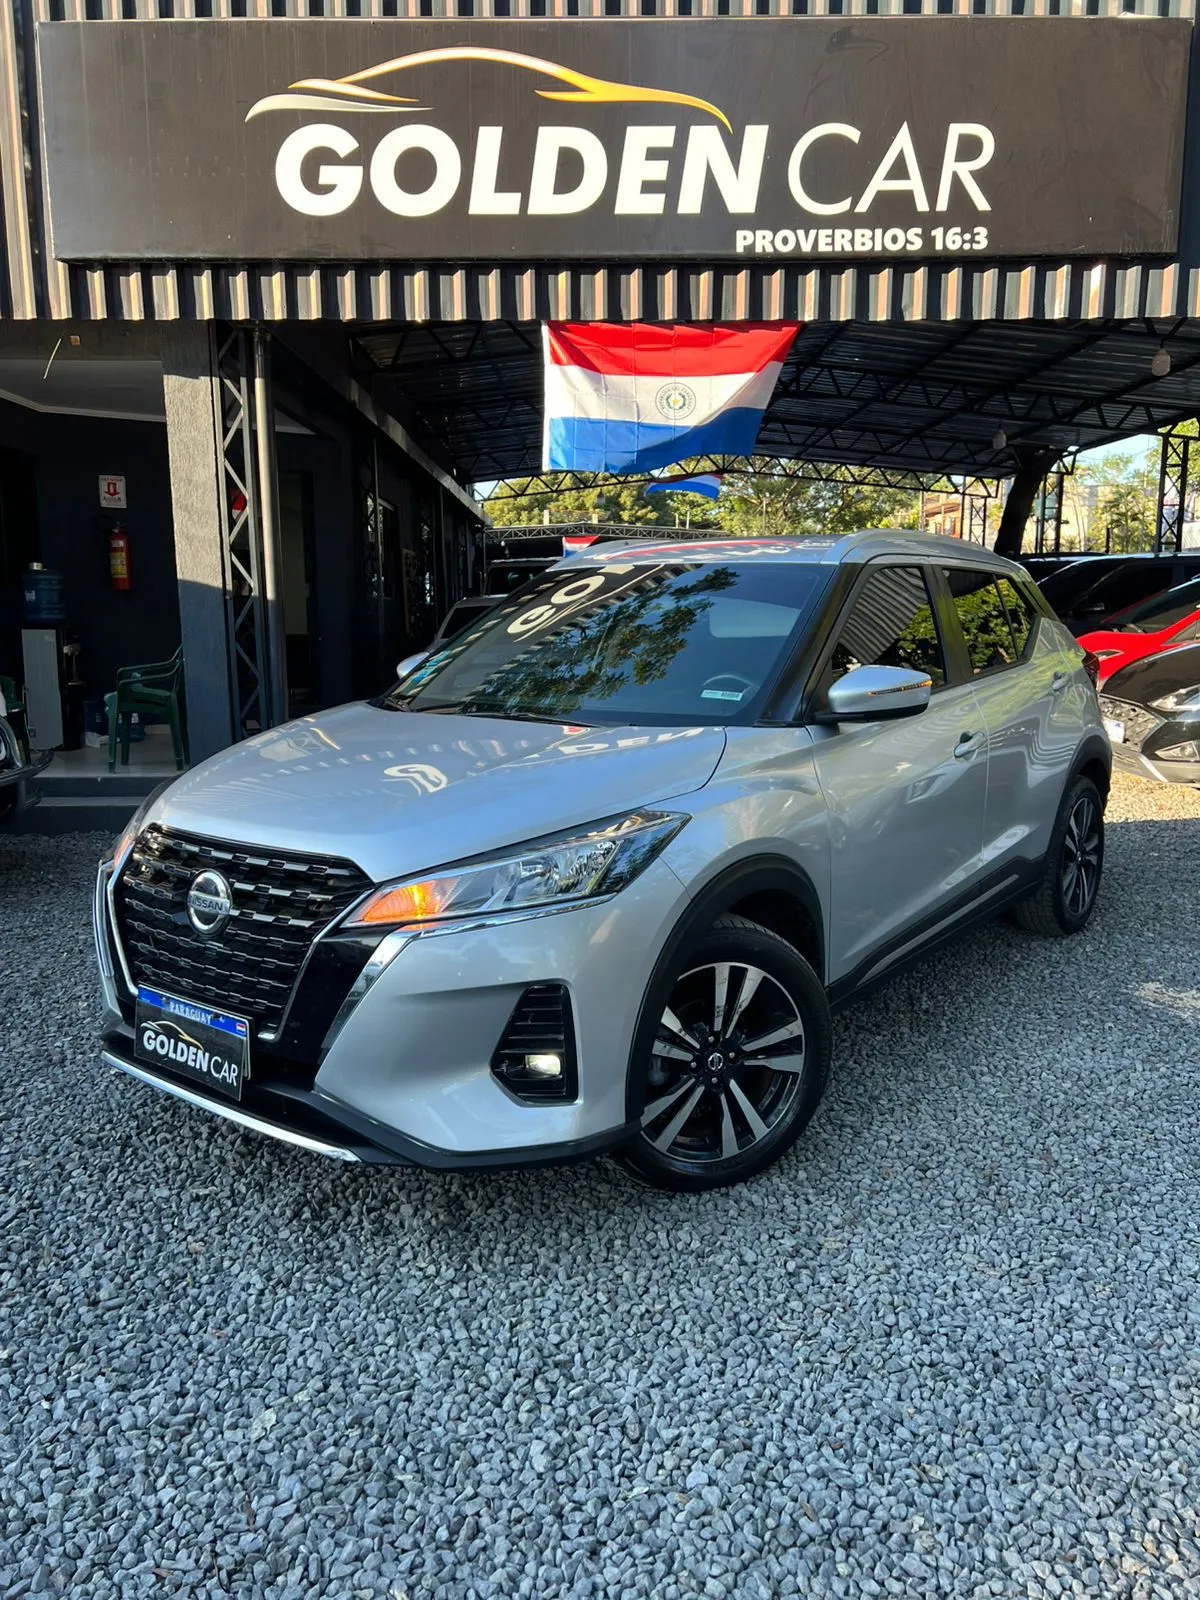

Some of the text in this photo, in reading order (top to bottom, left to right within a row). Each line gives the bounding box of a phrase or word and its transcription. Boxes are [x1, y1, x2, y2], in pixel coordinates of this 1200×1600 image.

[275, 121, 995, 217] GOLDEN CAR
[735, 226, 989, 253] PROVERBIOS 16:3
[191, 894, 224, 911] NISSAN
[169, 1002, 212, 1025] PARAGUAY
[143, 1030, 239, 1087] GOLDEN CAR
